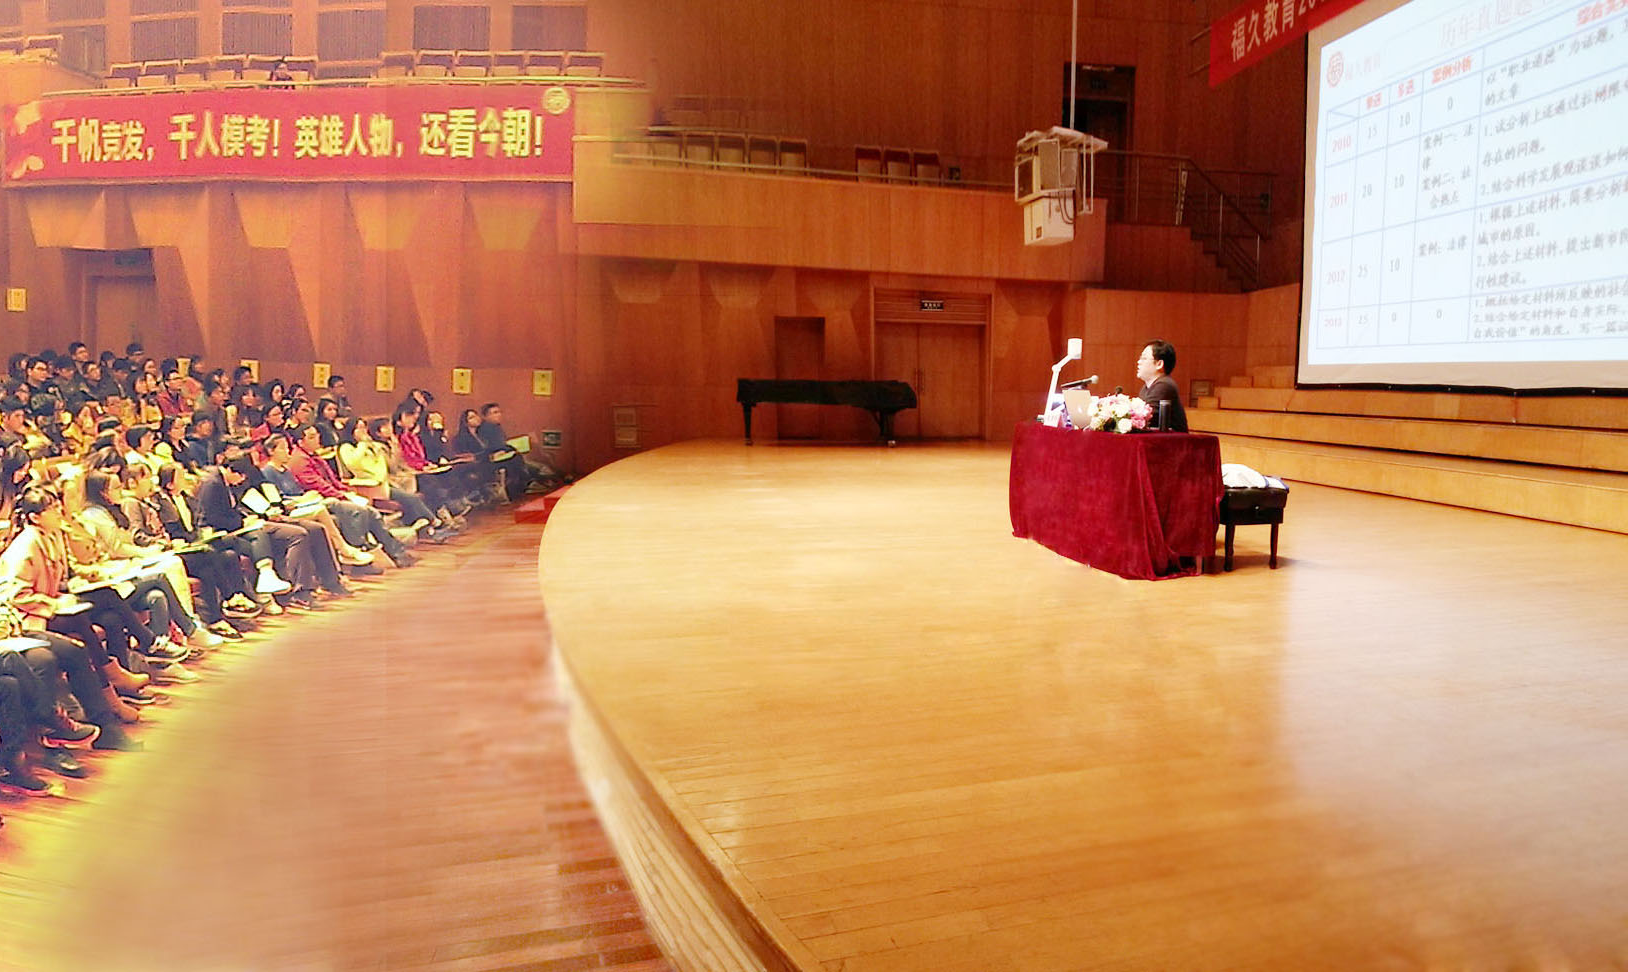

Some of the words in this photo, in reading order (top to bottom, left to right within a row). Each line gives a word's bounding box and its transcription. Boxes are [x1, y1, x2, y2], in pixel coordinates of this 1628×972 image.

[1399, 112, 1411, 127] 10
[1394, 174, 1405, 189] 10
[1390, 258, 1401, 273] 10
